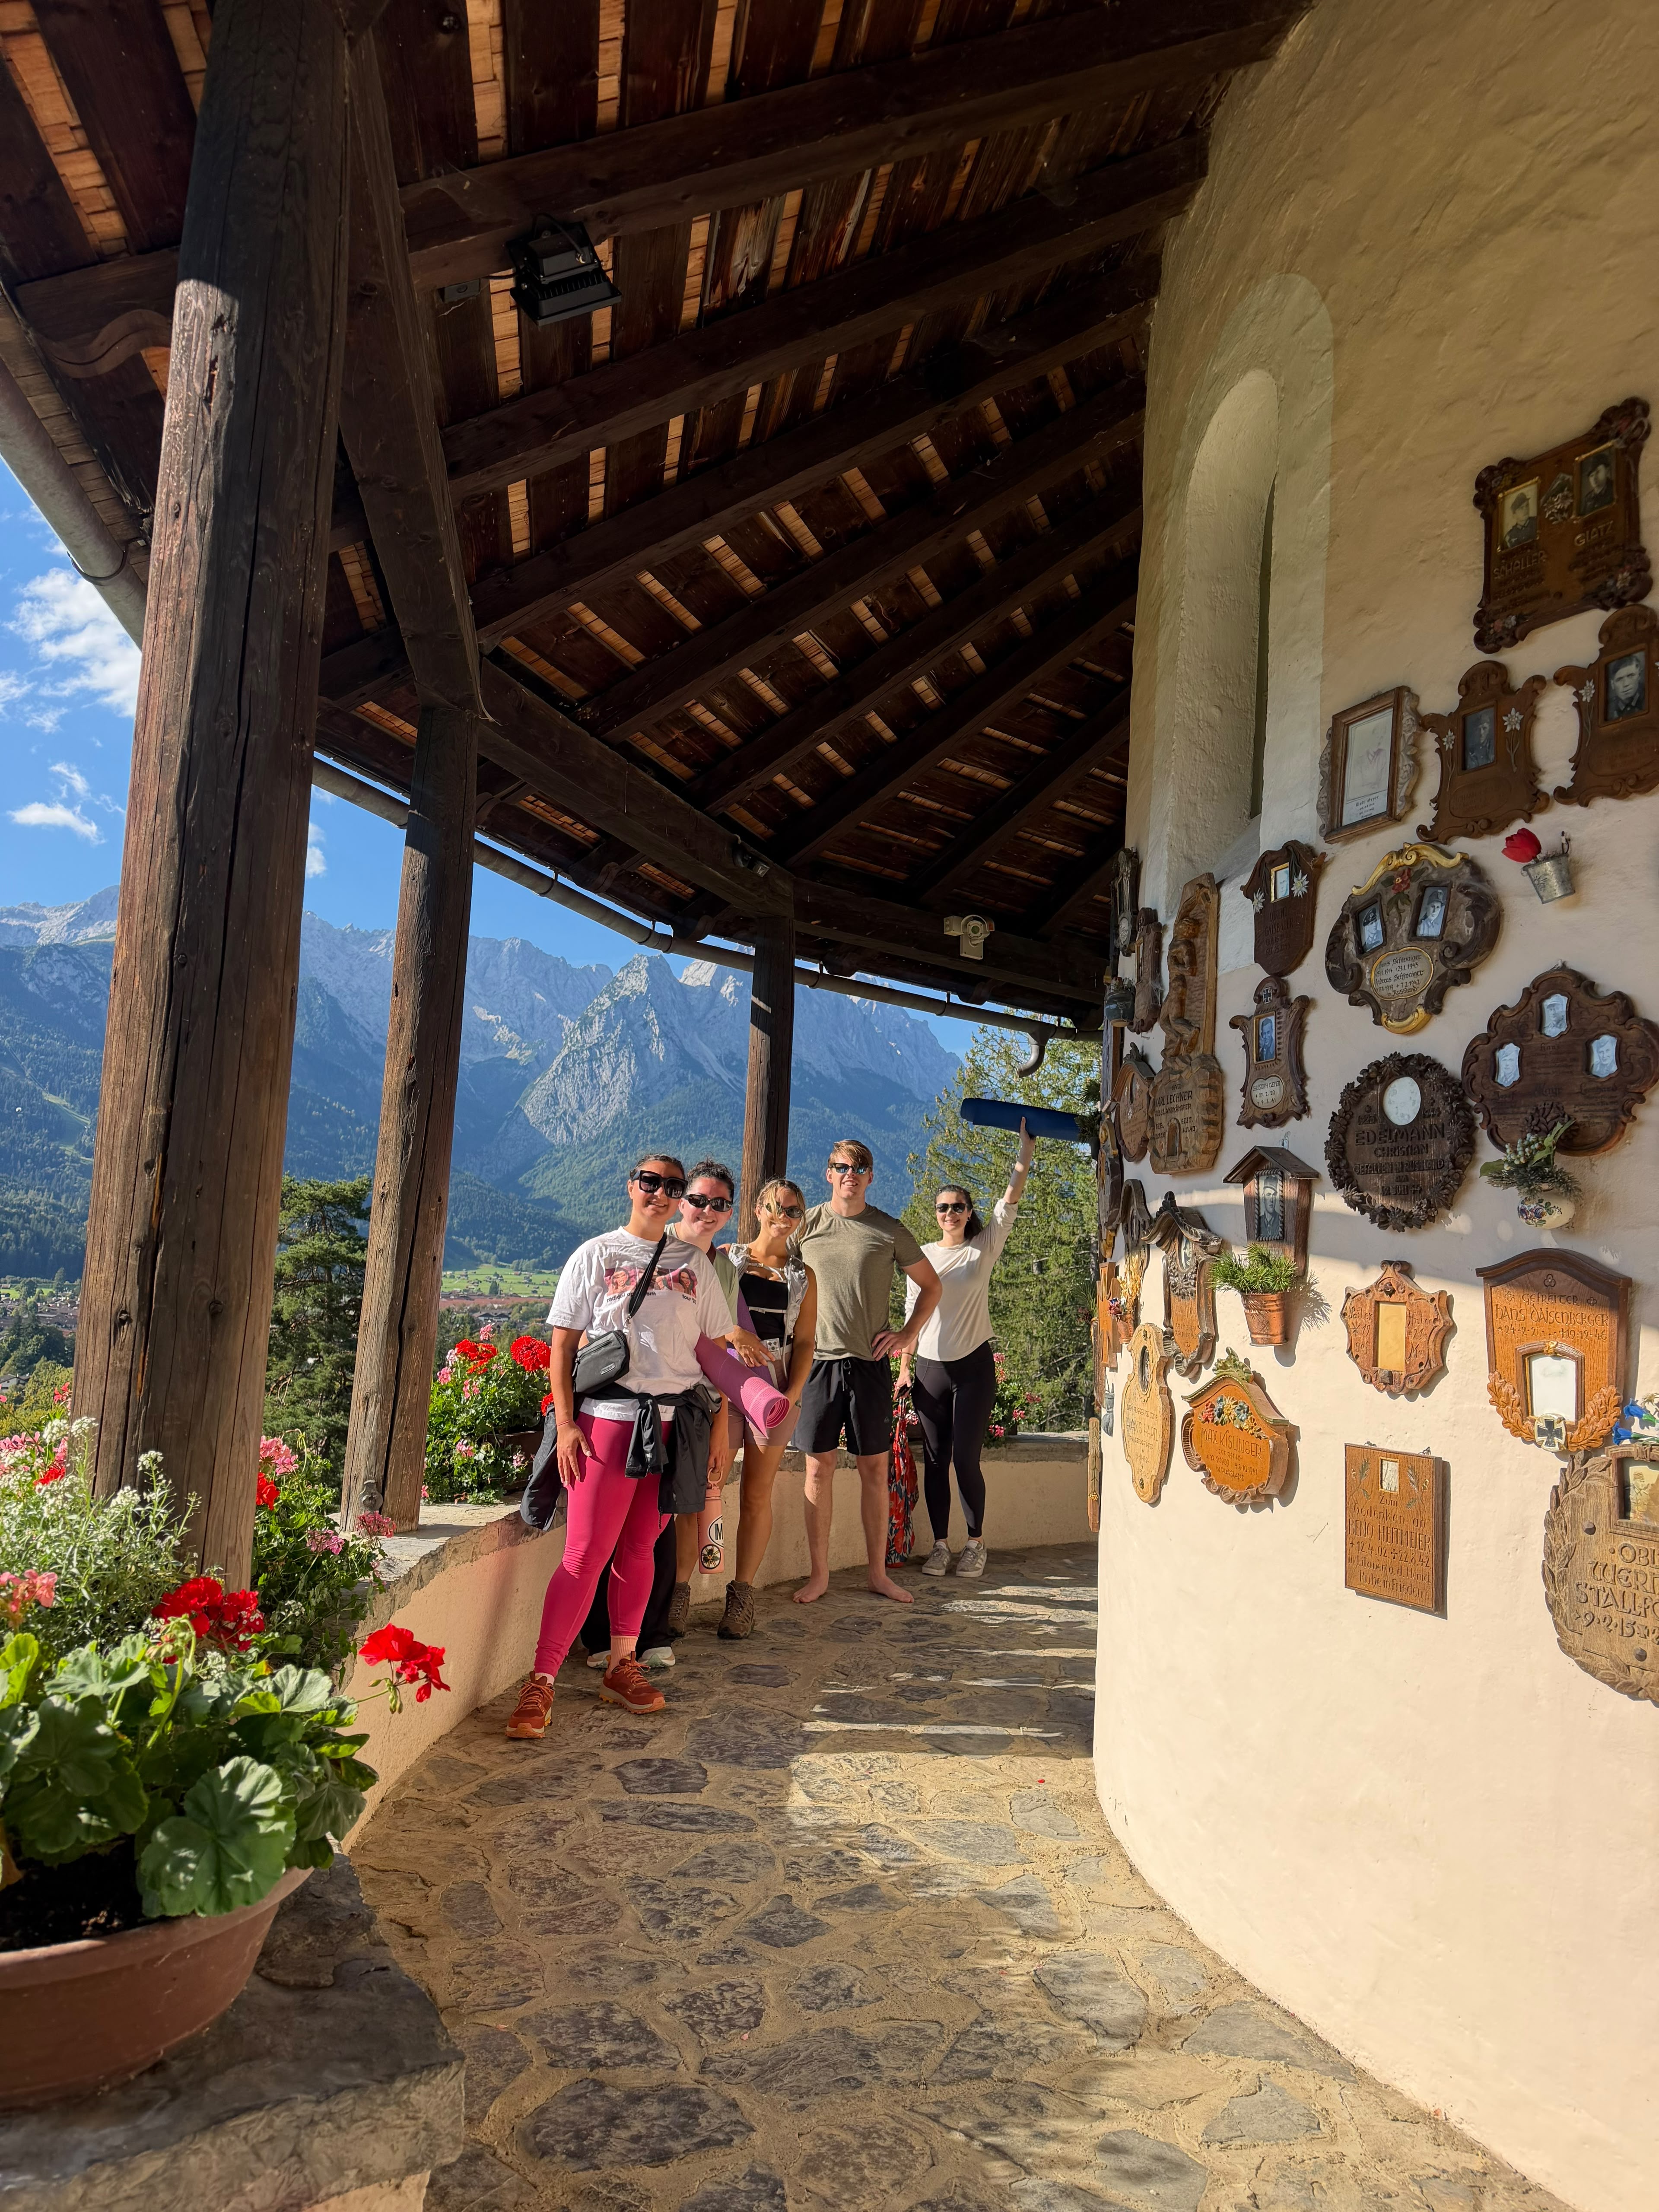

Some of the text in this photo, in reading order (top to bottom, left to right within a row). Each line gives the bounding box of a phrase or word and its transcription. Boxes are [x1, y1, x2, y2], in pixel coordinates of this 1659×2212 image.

[1574, 520, 1614, 547] GLATZ
[1493, 550, 1548, 579] SCHALLER
[1392, 986, 1417, 996] Russland
[1166, 1090, 1192, 1105] LECHNER
[1355, 1122, 1445, 1146] EDELMANN
[1374, 1143, 1428, 1157] CHRISTIAN
[1353, 1161, 1393, 1175] GEFALLEN
[1200, 1427, 1262, 1460] MAX KISLINGER
[1379, 1495, 1398, 1507] Zum
[1354, 1503, 1426, 1529] Gedenken an
[1348, 1518, 1431, 1552] BENO HEITMEIER
[1360, 1570, 1423, 1598] Ruhe in Frieden
